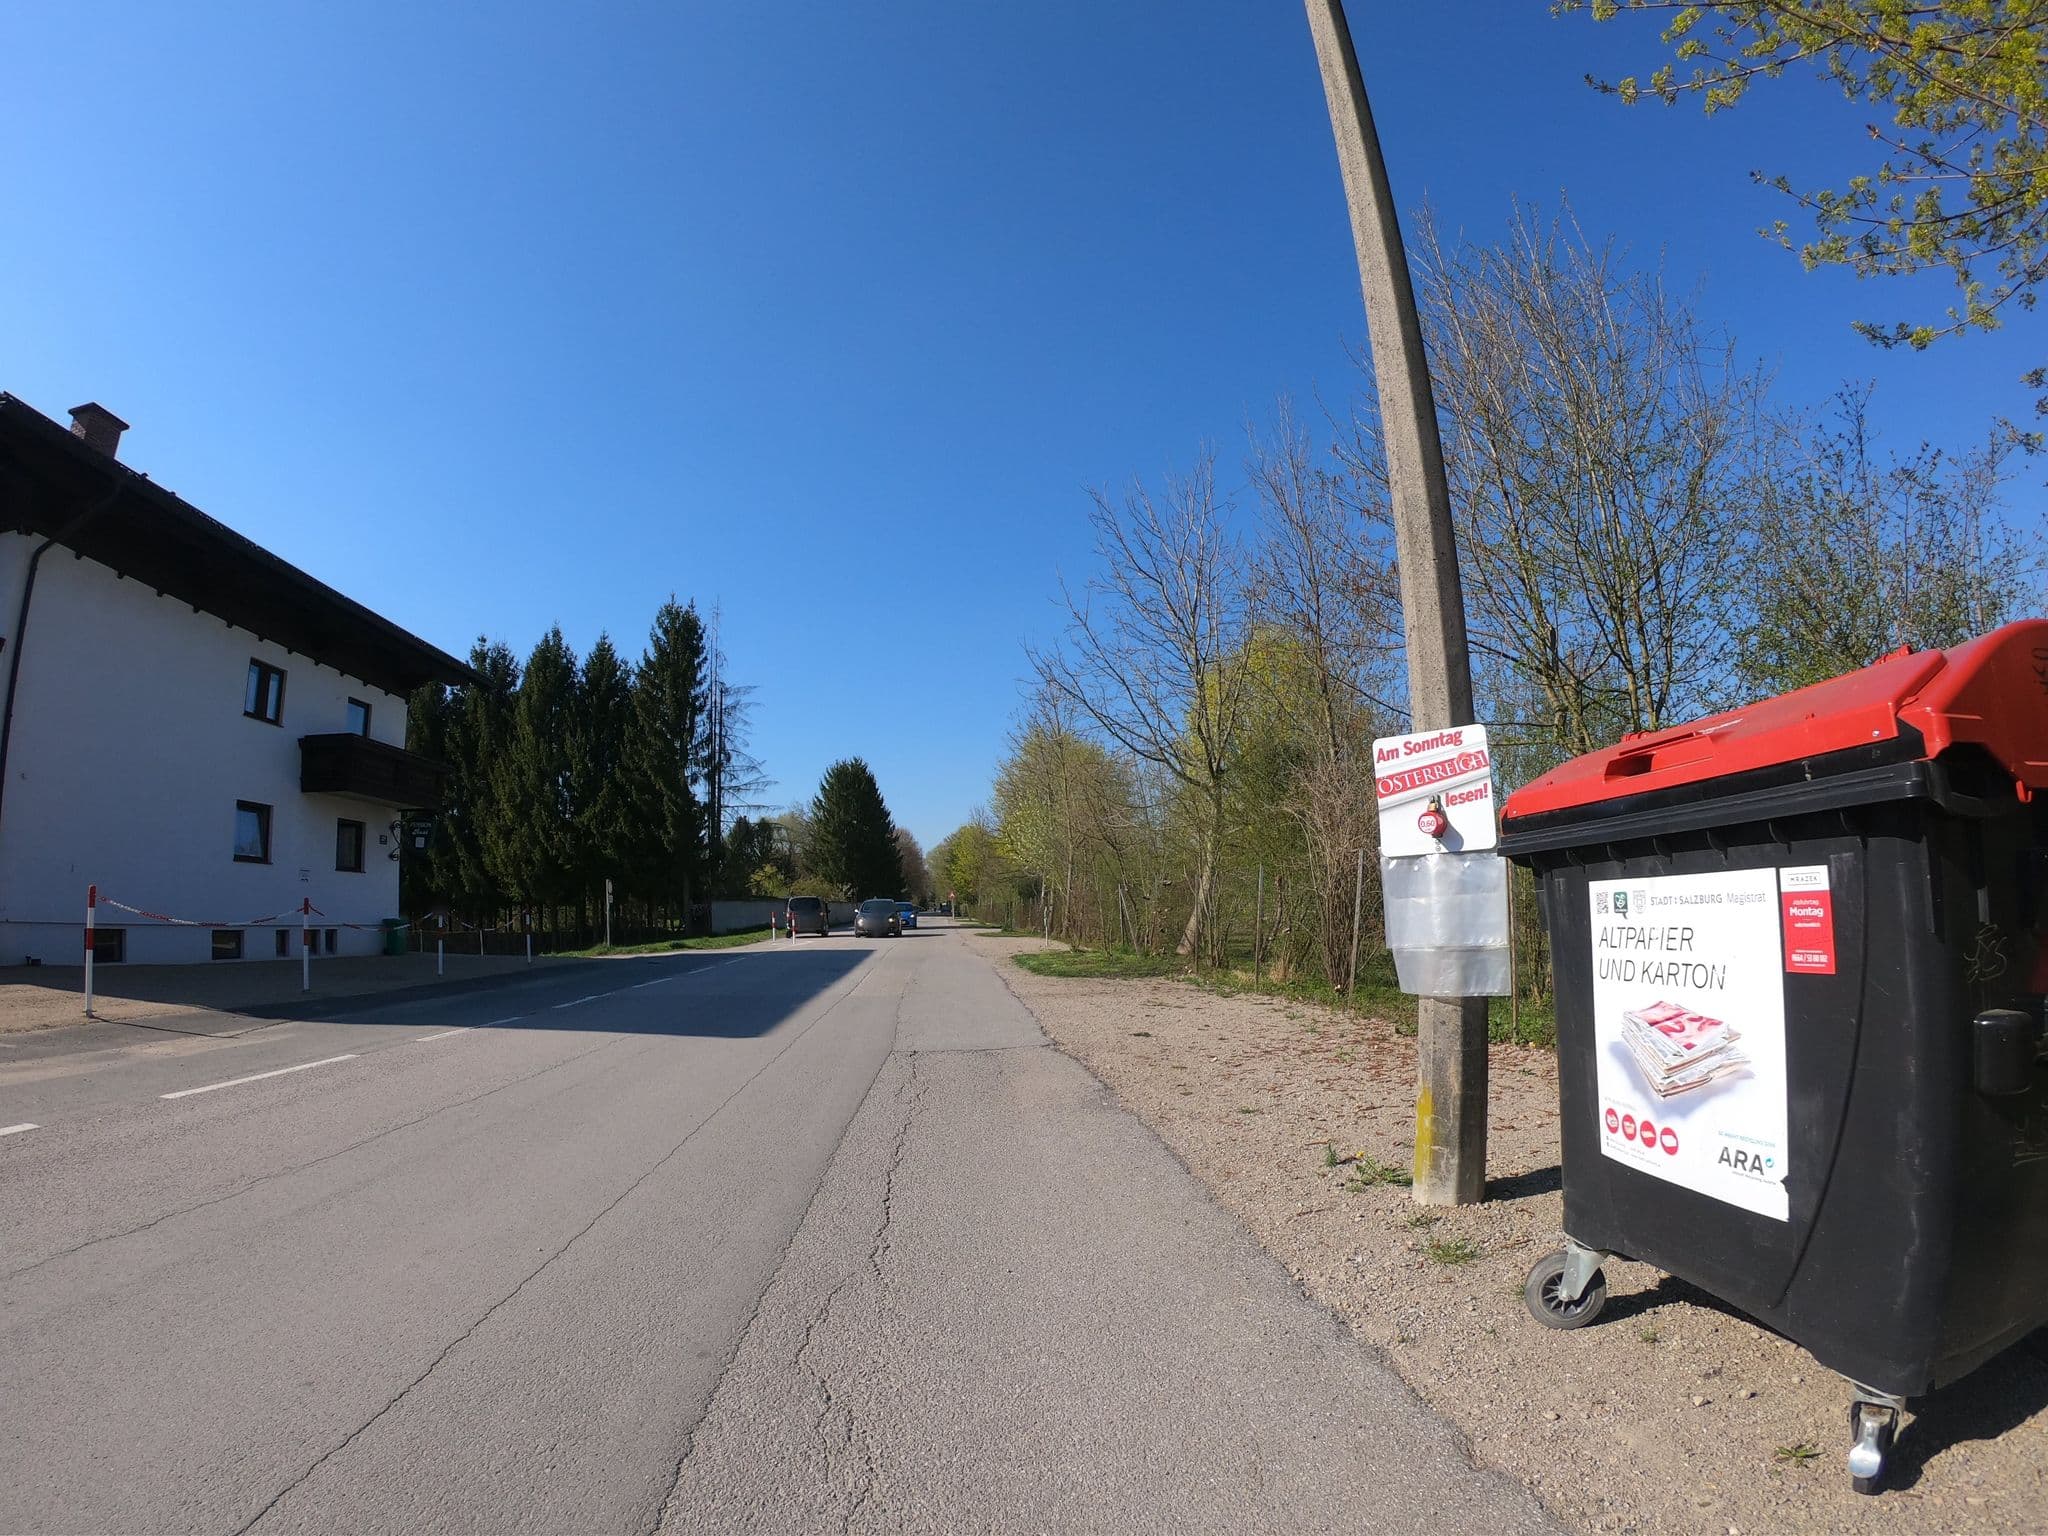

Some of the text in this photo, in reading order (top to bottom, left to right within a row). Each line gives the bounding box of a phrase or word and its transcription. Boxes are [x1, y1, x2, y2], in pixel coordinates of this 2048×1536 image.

[1376, 730, 1463, 764] Am Sonntag
[1378, 754, 1487, 794] ÖSTERREICH
[1445, 782, 1489, 808] lesen!
[1650, 896, 1673, 906] STADT
[1679, 893, 1723, 905] SALZBURG
[1726, 892, 1766, 906] Magistrat
[1789, 907, 1824, 917] Montag
[1598, 926, 1694, 951] ALTPAPIER
[1599, 957, 1726, 990] UND KARTON
[1718, 1146, 1764, 1176] ARA
